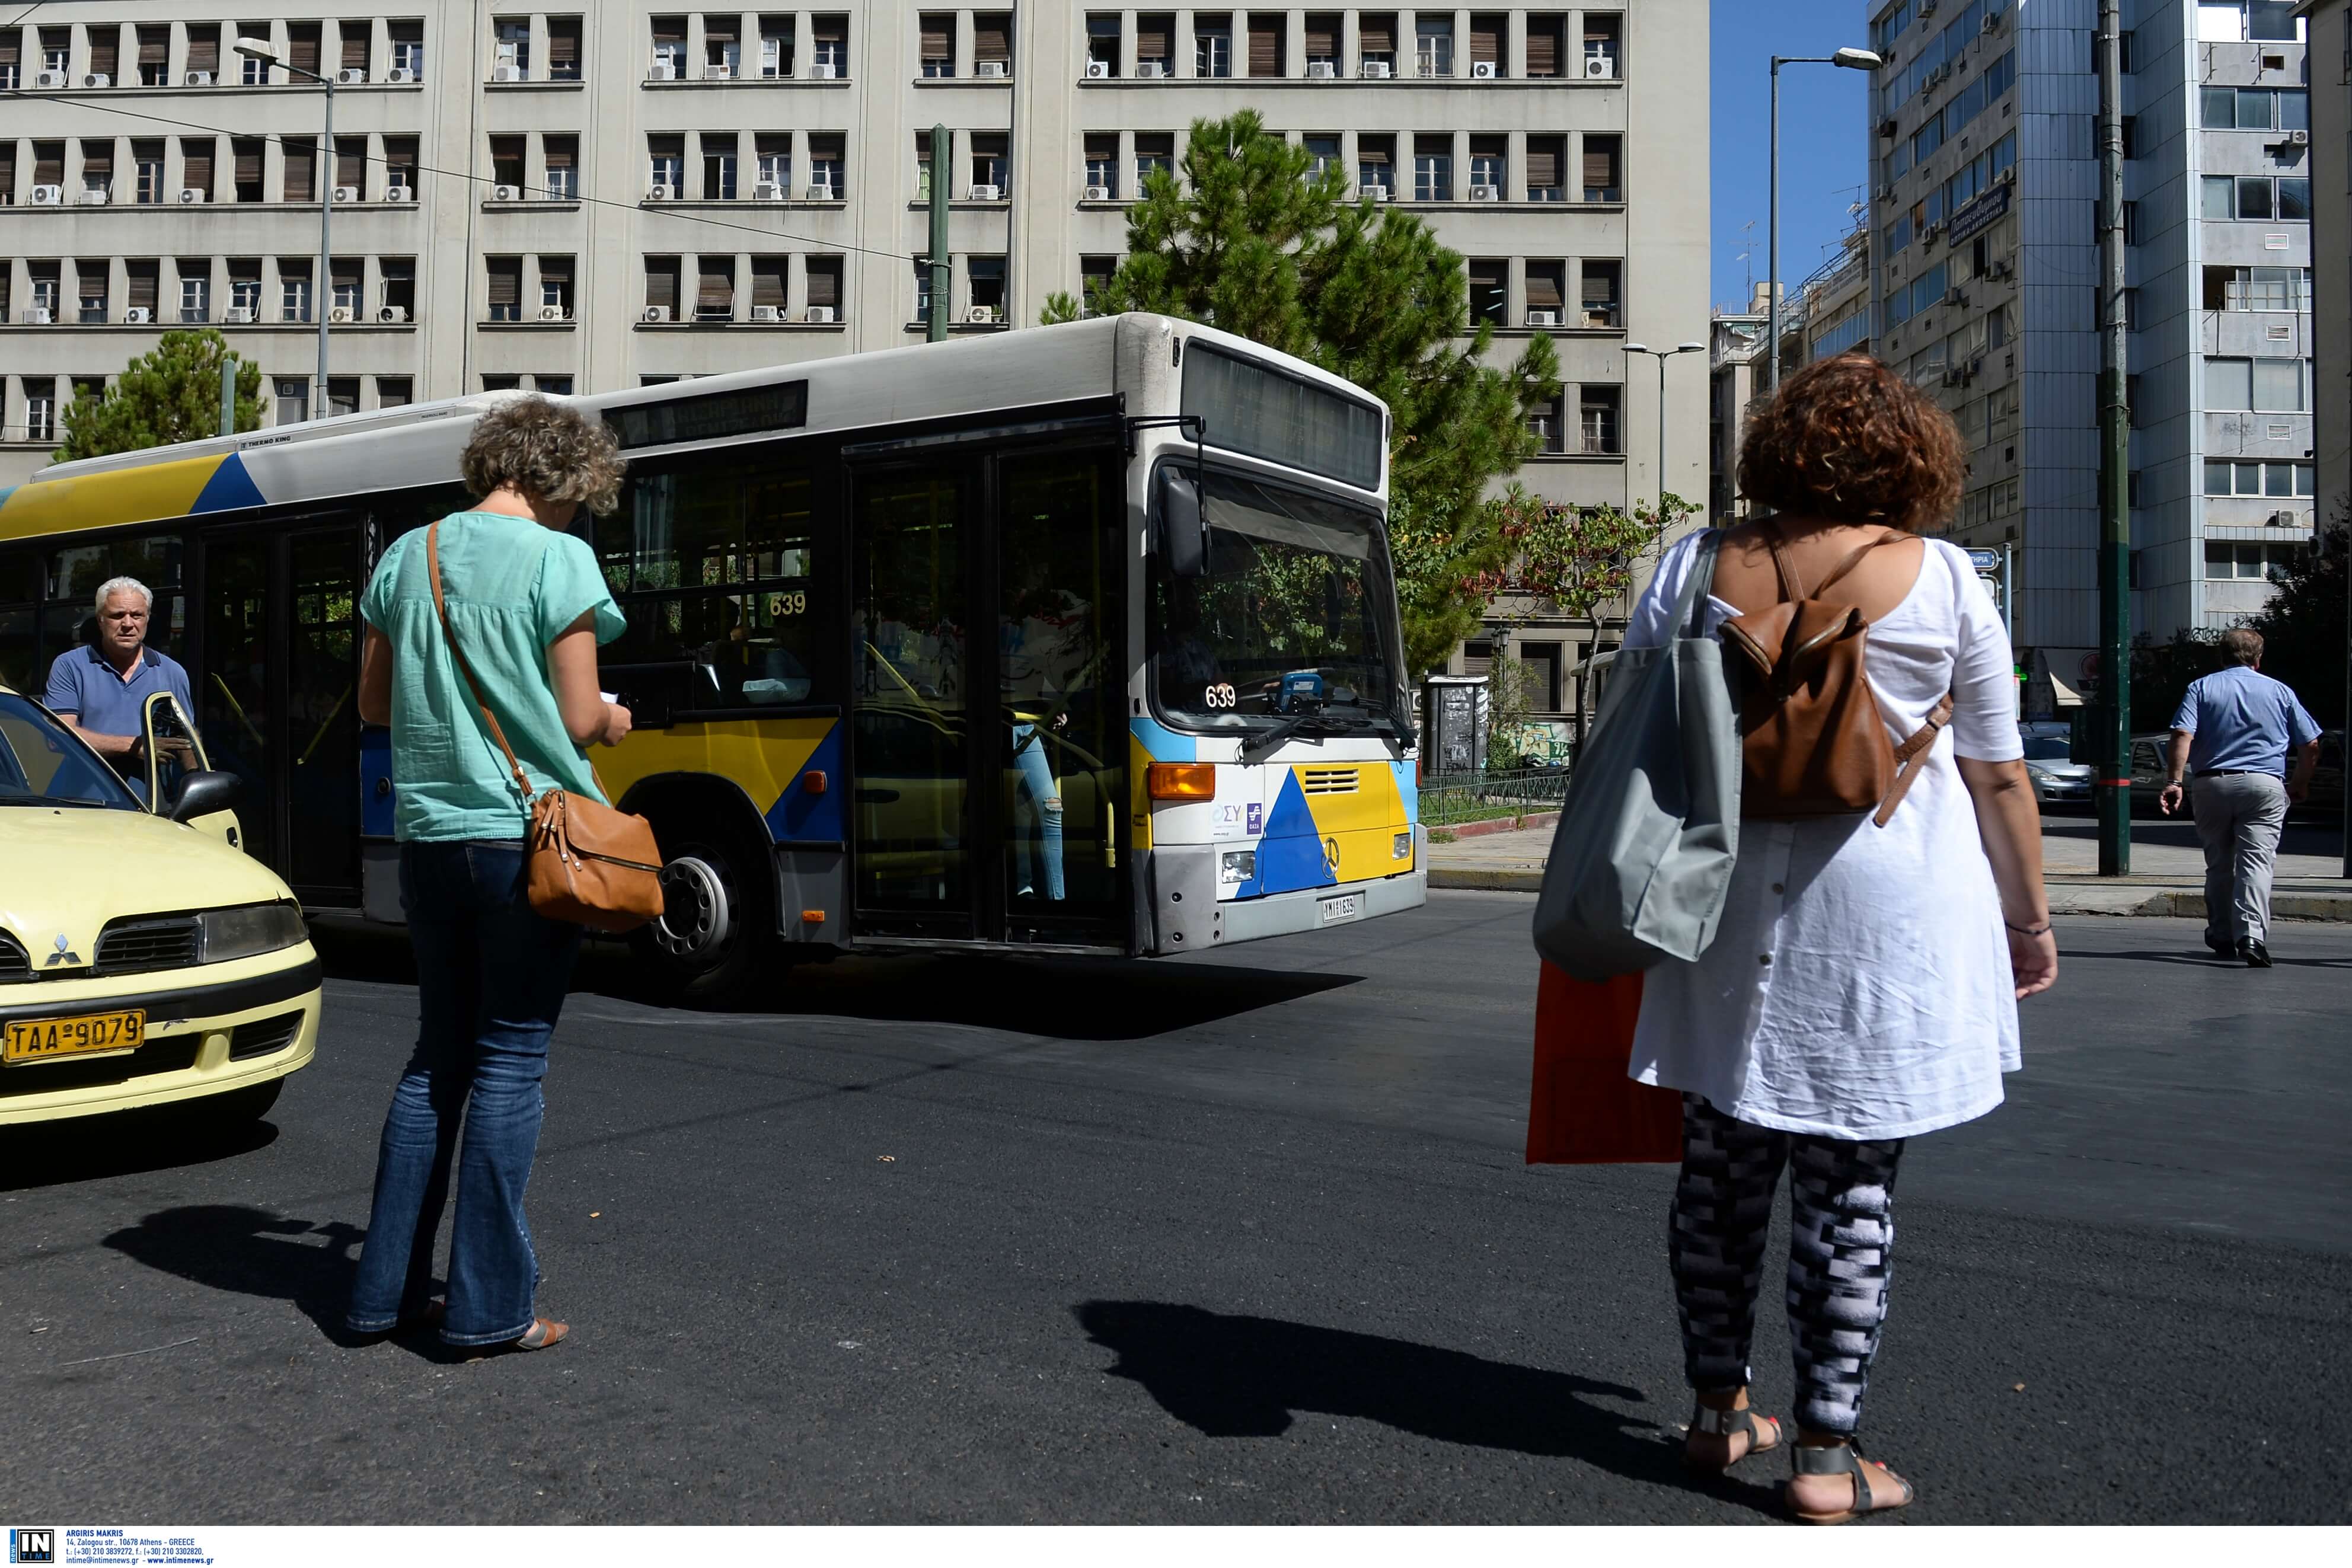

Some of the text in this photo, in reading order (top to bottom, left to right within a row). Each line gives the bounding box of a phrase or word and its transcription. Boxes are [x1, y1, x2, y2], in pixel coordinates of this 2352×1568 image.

[248, 438, 273, 447] THERMO
[770, 594, 806, 616] 639
[1206, 685, 1236, 707] 639
